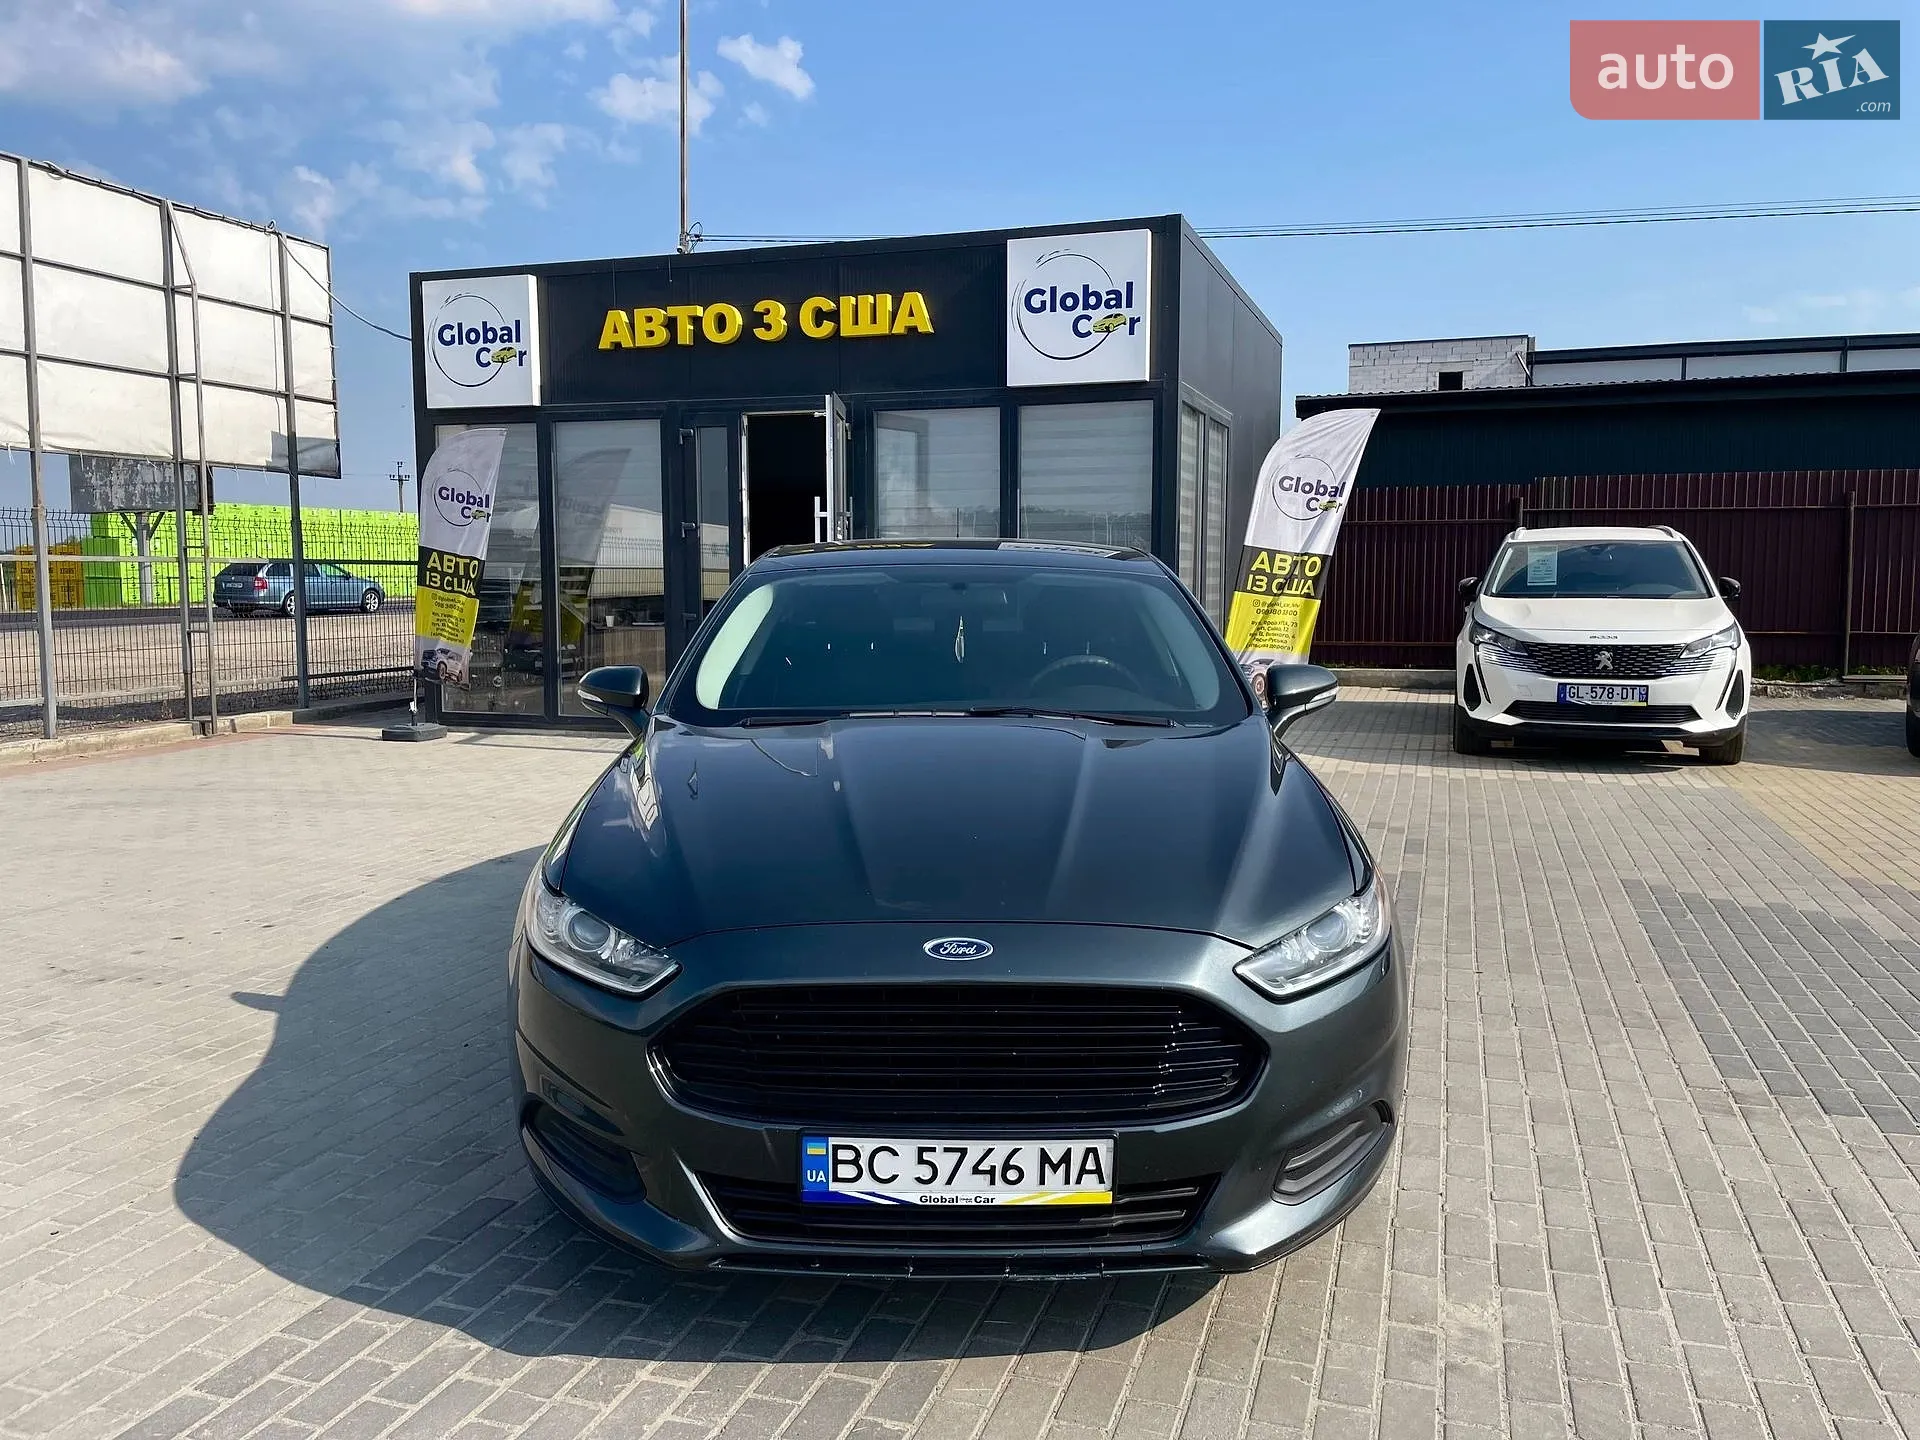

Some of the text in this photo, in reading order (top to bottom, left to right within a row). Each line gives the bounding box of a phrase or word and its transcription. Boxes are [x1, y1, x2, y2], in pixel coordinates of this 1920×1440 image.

[1023, 281, 1134, 315] Global
[598, 302, 743, 350] АВТО
[799, 291, 935, 340] США
[1071, 312, 1141, 339] Cr
[437, 319, 521, 347] Global
[475, 346, 527, 368] Cr
[438, 486, 490, 509] Global
[1278, 475, 1347, 498] Global
[460, 506, 491, 523] Cr
[1305, 496, 1343, 514] Cr
[426, 551, 479, 579] АВТО
[1250, 550, 1322, 577] АВТО
[443, 575, 476, 596] США
[1271, 578, 1315, 597] США
[939, 941, 977, 955] Ford
[806, 1169, 826, 1183] UA
[831, 1143, 1106, 1187] BC 5746 MA
[919, 1195, 959, 1204] Global
[973, 1195, 996, 1204] Car
